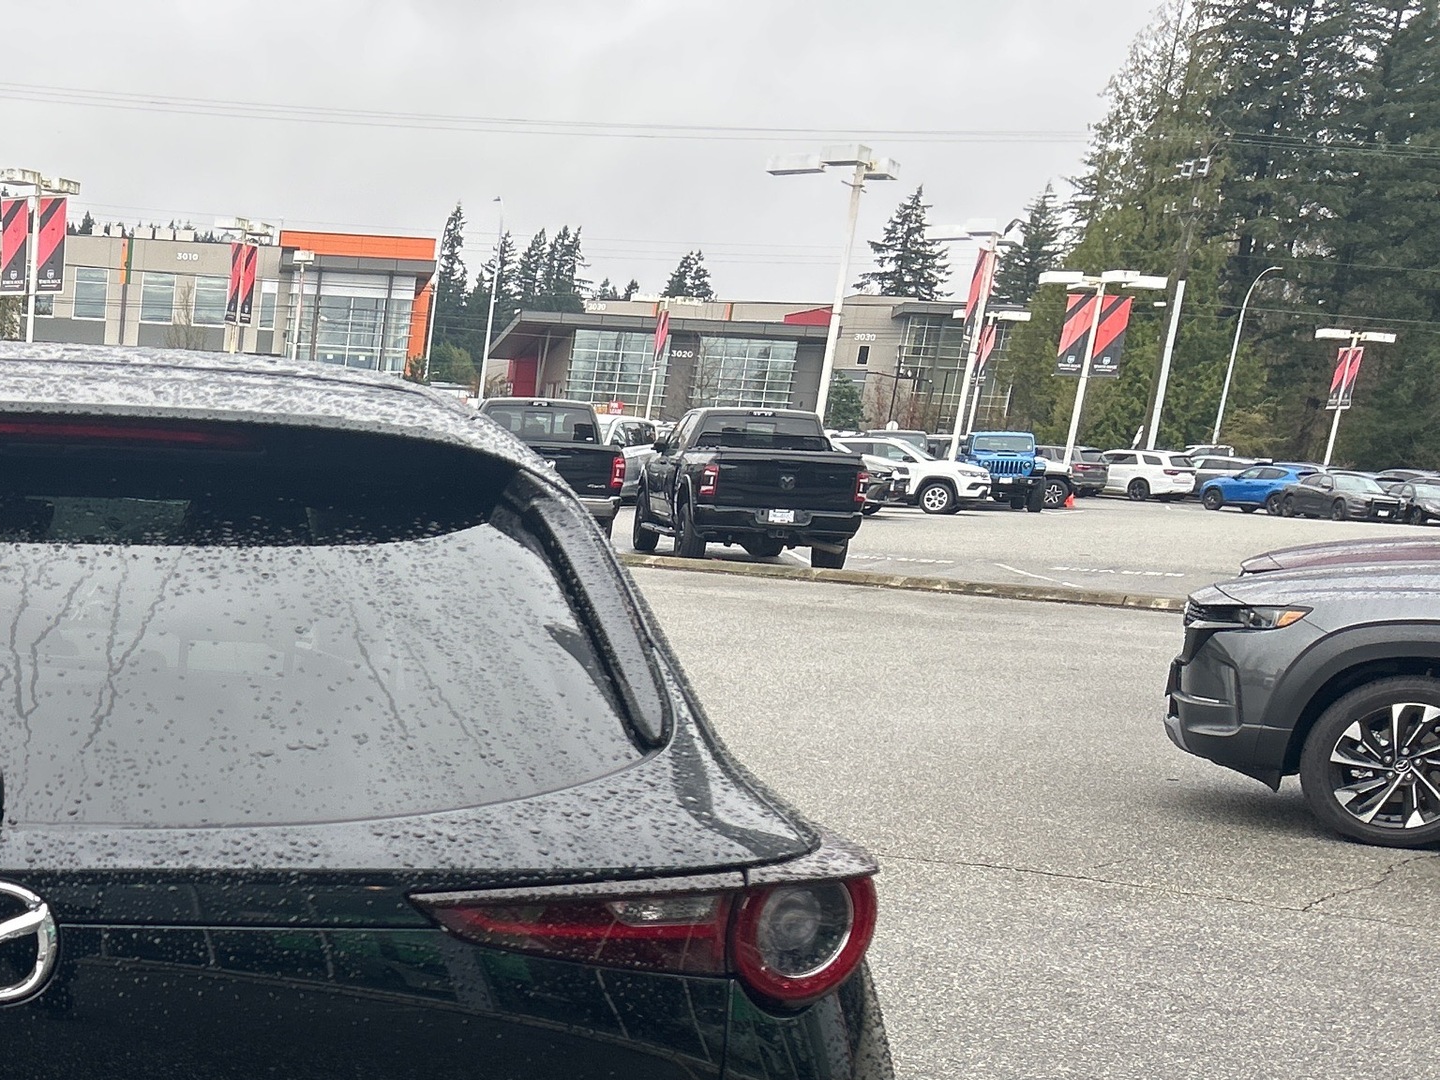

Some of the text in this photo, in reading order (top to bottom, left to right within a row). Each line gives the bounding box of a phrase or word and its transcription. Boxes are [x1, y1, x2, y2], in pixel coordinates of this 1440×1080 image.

[176, 252, 199, 261] 3010
[854, 333, 877, 341] 3030
[671, 350, 694, 358] 3020
